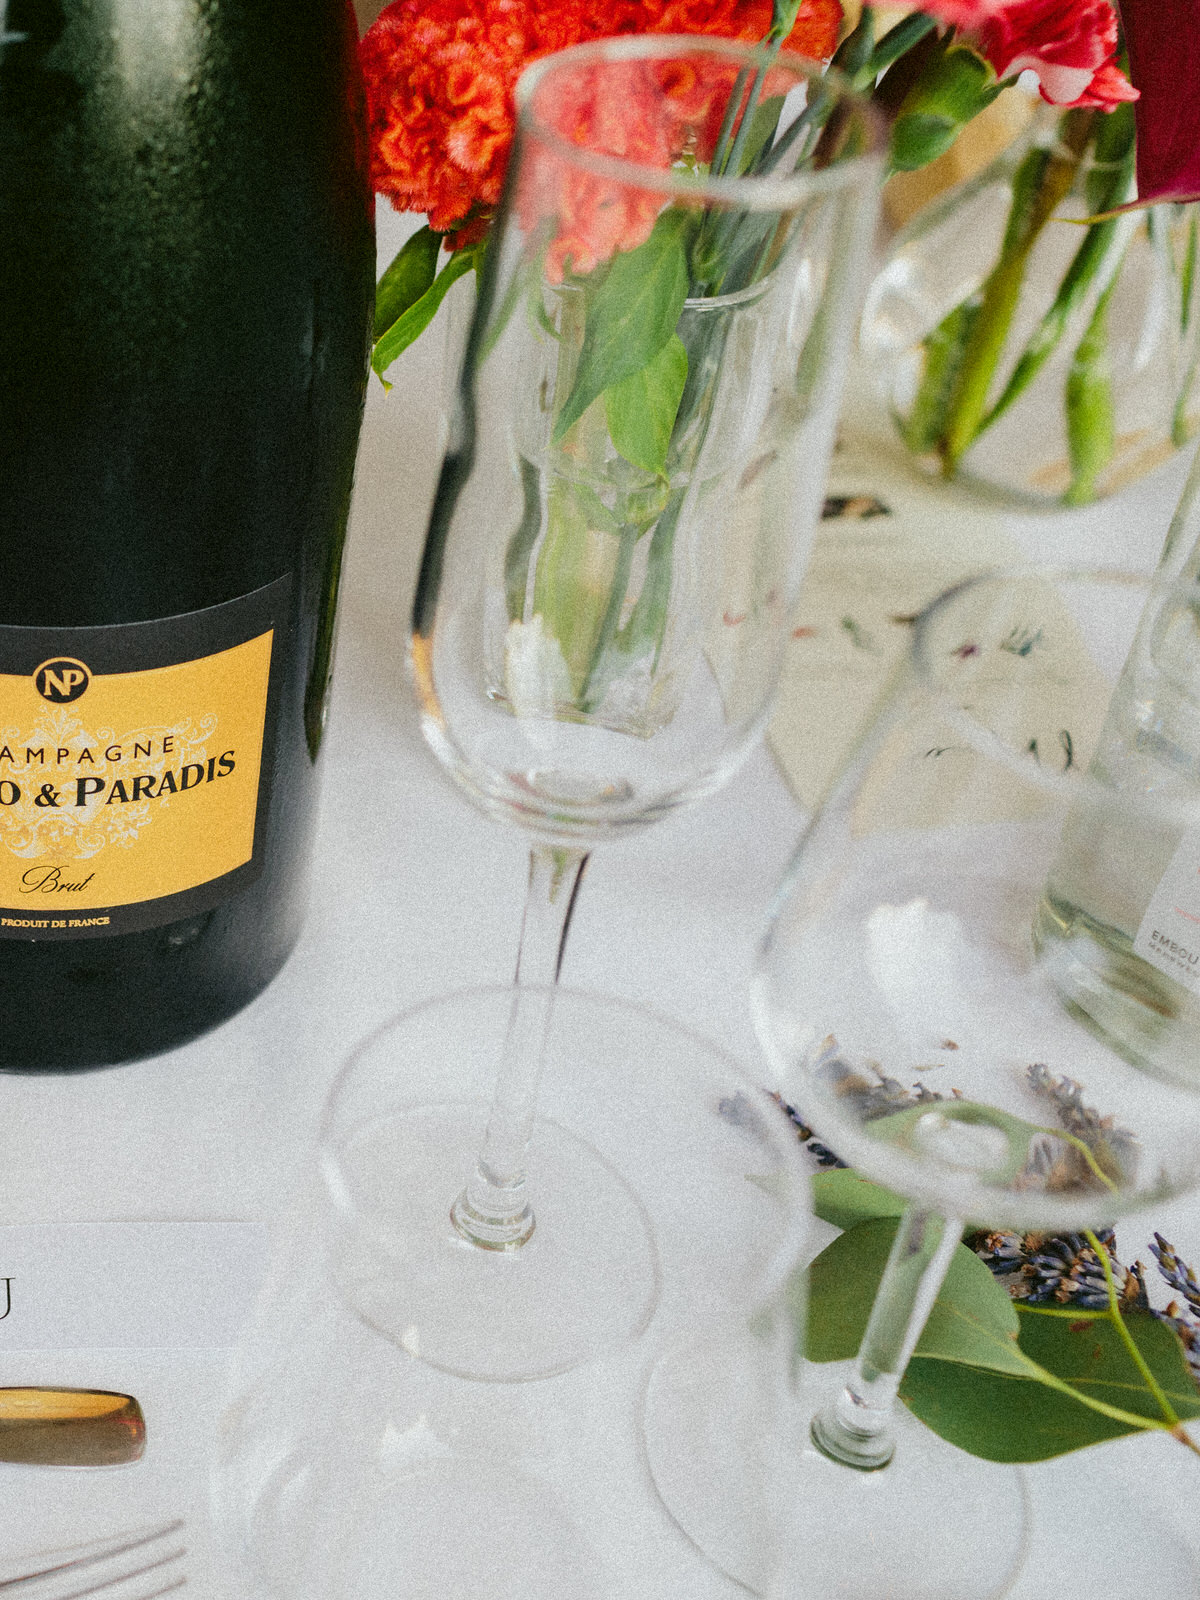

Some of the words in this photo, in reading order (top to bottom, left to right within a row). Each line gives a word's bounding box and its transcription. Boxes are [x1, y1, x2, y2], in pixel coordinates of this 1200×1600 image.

[42, 669, 84, 697] NP
[34, 783, 61, 807] &
[74, 750, 237, 808] PARADIS
[19, 865, 96, 894] Brut
[0, 917, 50, 928] PRODUIT
[51, 919, 67, 929] DE
[68, 916, 111, 928] FRANCE
